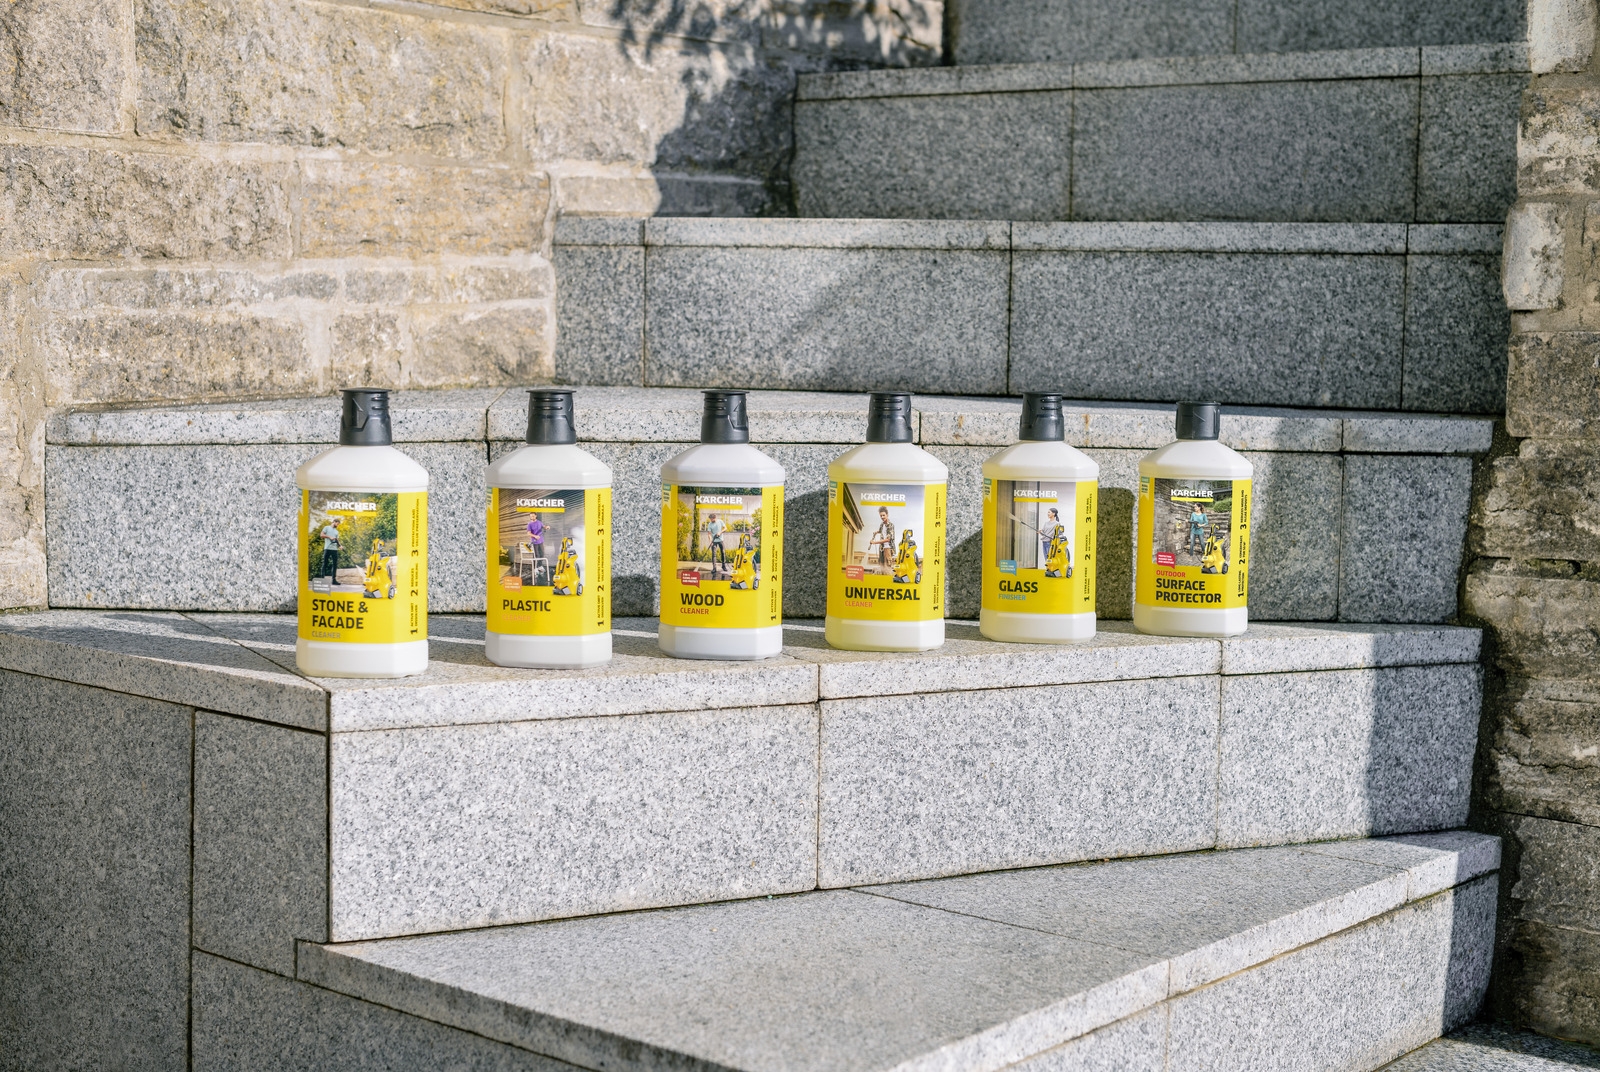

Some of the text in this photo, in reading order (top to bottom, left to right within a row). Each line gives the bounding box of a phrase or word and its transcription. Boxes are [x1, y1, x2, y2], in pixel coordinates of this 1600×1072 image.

[860, 492, 906, 502] KÄRCHER
[1014, 489, 1058, 498] KÄRCHER
[1171, 489, 1214, 498] KÄRCHER
[517, 498, 565, 507] KÄRCHER
[696, 495, 743, 505] KÄRCHER
[326, 501, 377, 511] KÄRCHER
[1156, 569, 1186, 578] OUTDOOR
[998, 580, 1038, 593] GLASS
[1156, 578, 1206, 591] SURFACE
[845, 586, 920, 601] UNIVERSAL
[1156, 590, 1222, 603] PROTECTOR
[681, 593, 724, 606] WOOD
[312, 599, 368, 613] STONE &
[503, 599, 551, 612] PLASTIC
[312, 615, 364, 629] FACADE
[312, 631, 341, 639] CLEANER
